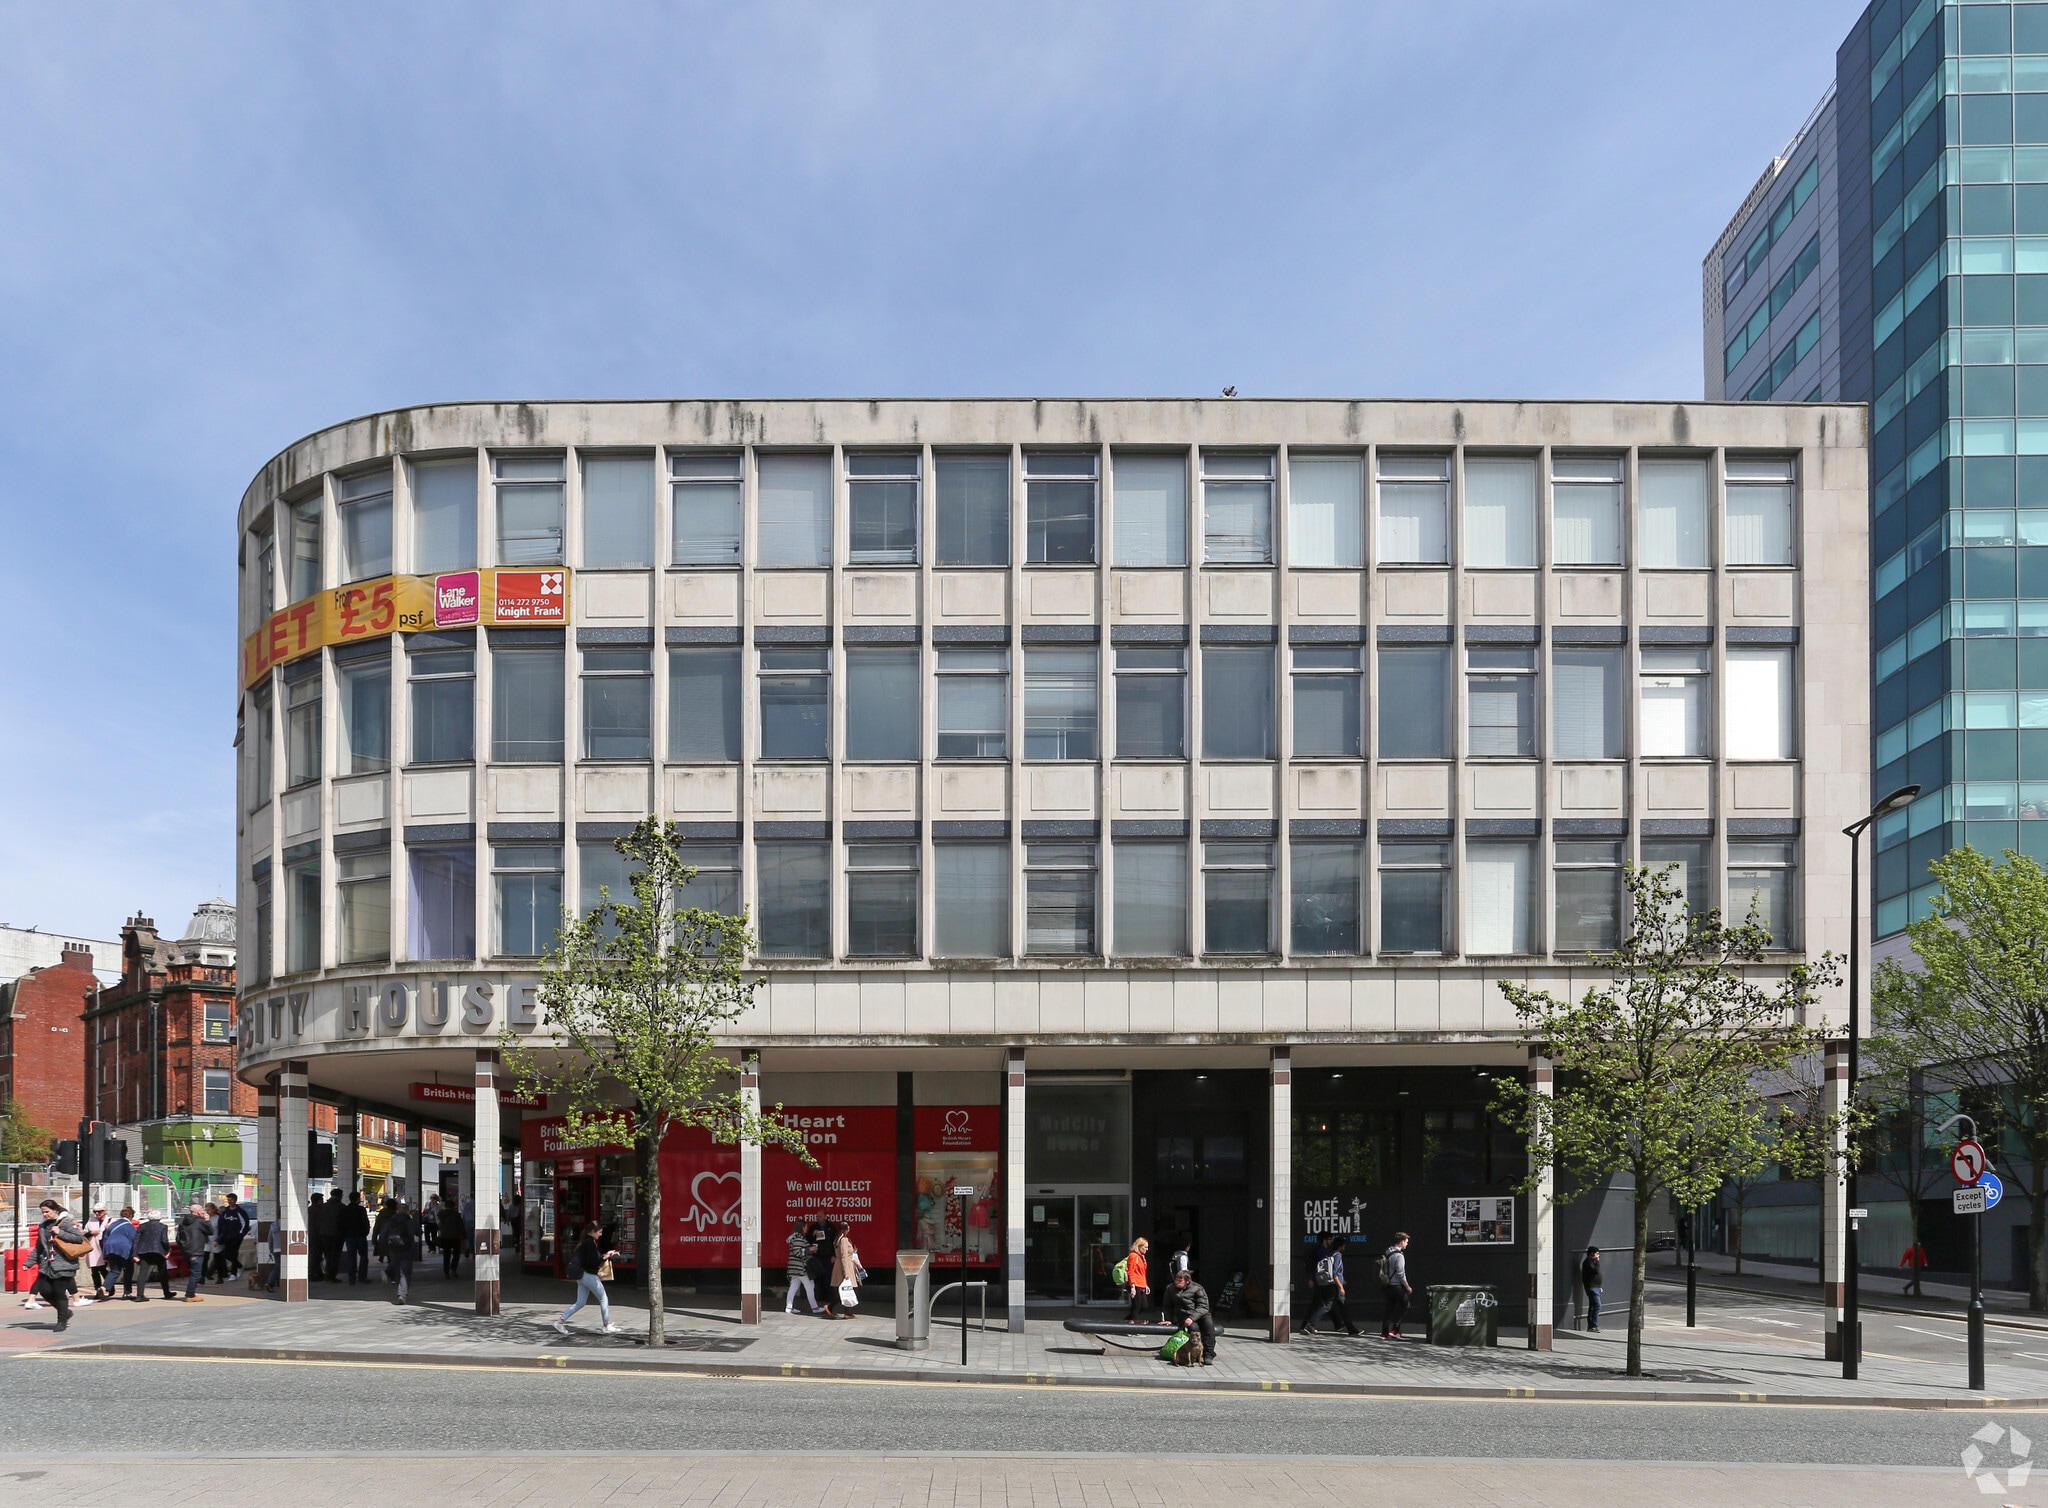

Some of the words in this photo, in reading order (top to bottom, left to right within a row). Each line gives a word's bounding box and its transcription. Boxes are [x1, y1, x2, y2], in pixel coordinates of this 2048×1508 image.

[439, 587, 466, 599] Lane
[439, 596, 476, 609] Walker
[499, 598, 515, 606] 0114
[517, 598, 530, 606] 272
[531, 598, 550, 606] 9750
[340, 582, 396, 637] £5
[399, 611, 424, 627] psf
[498, 606, 531, 618] Knight
[534, 606, 562, 616] Frank
[256, 601, 315, 675] LET
[239, 992, 310, 1052] CITY
[344, 978, 539, 1030] HOUSE
[423, 1087, 456, 1099] British
[458, 1090, 476, 1100] Hea
[499, 1095, 539, 1107] undation
[784, 1114, 845, 1128] Heart
[786, 1181, 802, 1191] We
[804, 1181, 822, 1191] will
[824, 1181, 872, 1191] COLLECT
[786, 1197, 804, 1207] call
[806, 1197, 834, 1207] 01142
[836, 1197, 872, 1207] 753301
[1956, 1192, 1982, 1201] Except
[1304, 1196, 1339, 1217] CAFÉ
[1957, 1202, 1982, 1211] cycles
[786, 1214, 797, 1222] for
[804, 1214, 818, 1222] FRE
[826, 1214, 872, 1222] COLLECTION
[1304, 1216, 1351, 1233] TOTEM
